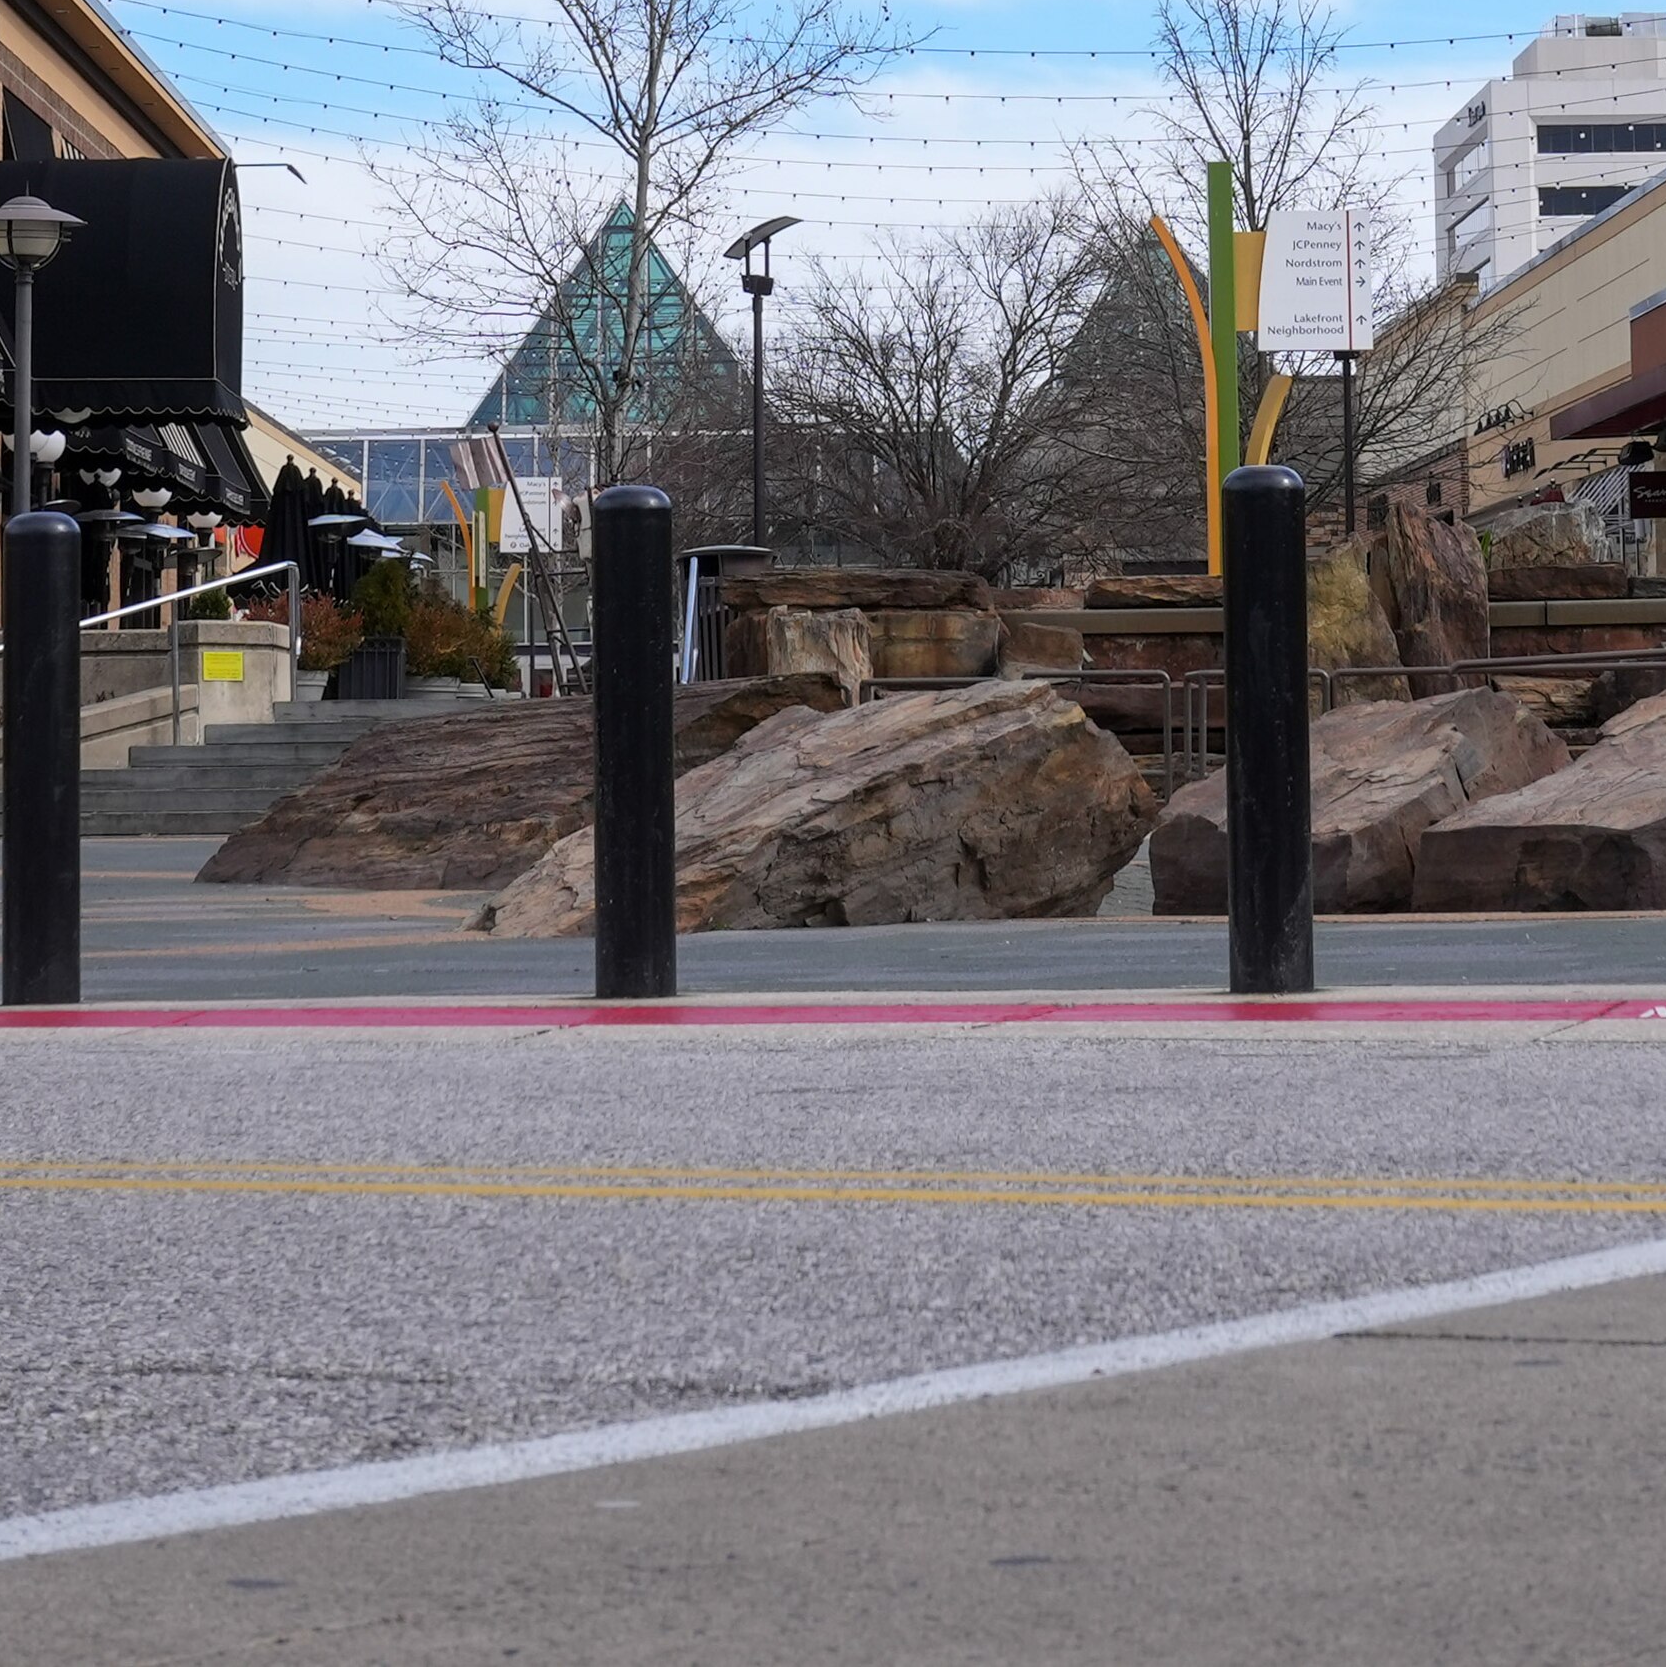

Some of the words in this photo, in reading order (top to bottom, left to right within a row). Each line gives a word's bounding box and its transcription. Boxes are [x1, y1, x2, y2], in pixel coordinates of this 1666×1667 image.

[1306, 221, 1342, 233] Macy's
[1292, 239, 1342, 251] JCPenney
[1285, 258, 1343, 268] Nordstrom
[1296, 277, 1318, 286] Main
[1318, 277, 1343, 286] Event
[1294, 313, 1343, 323] Lakefront
[1267, 324, 1345, 337] Neighborhood
